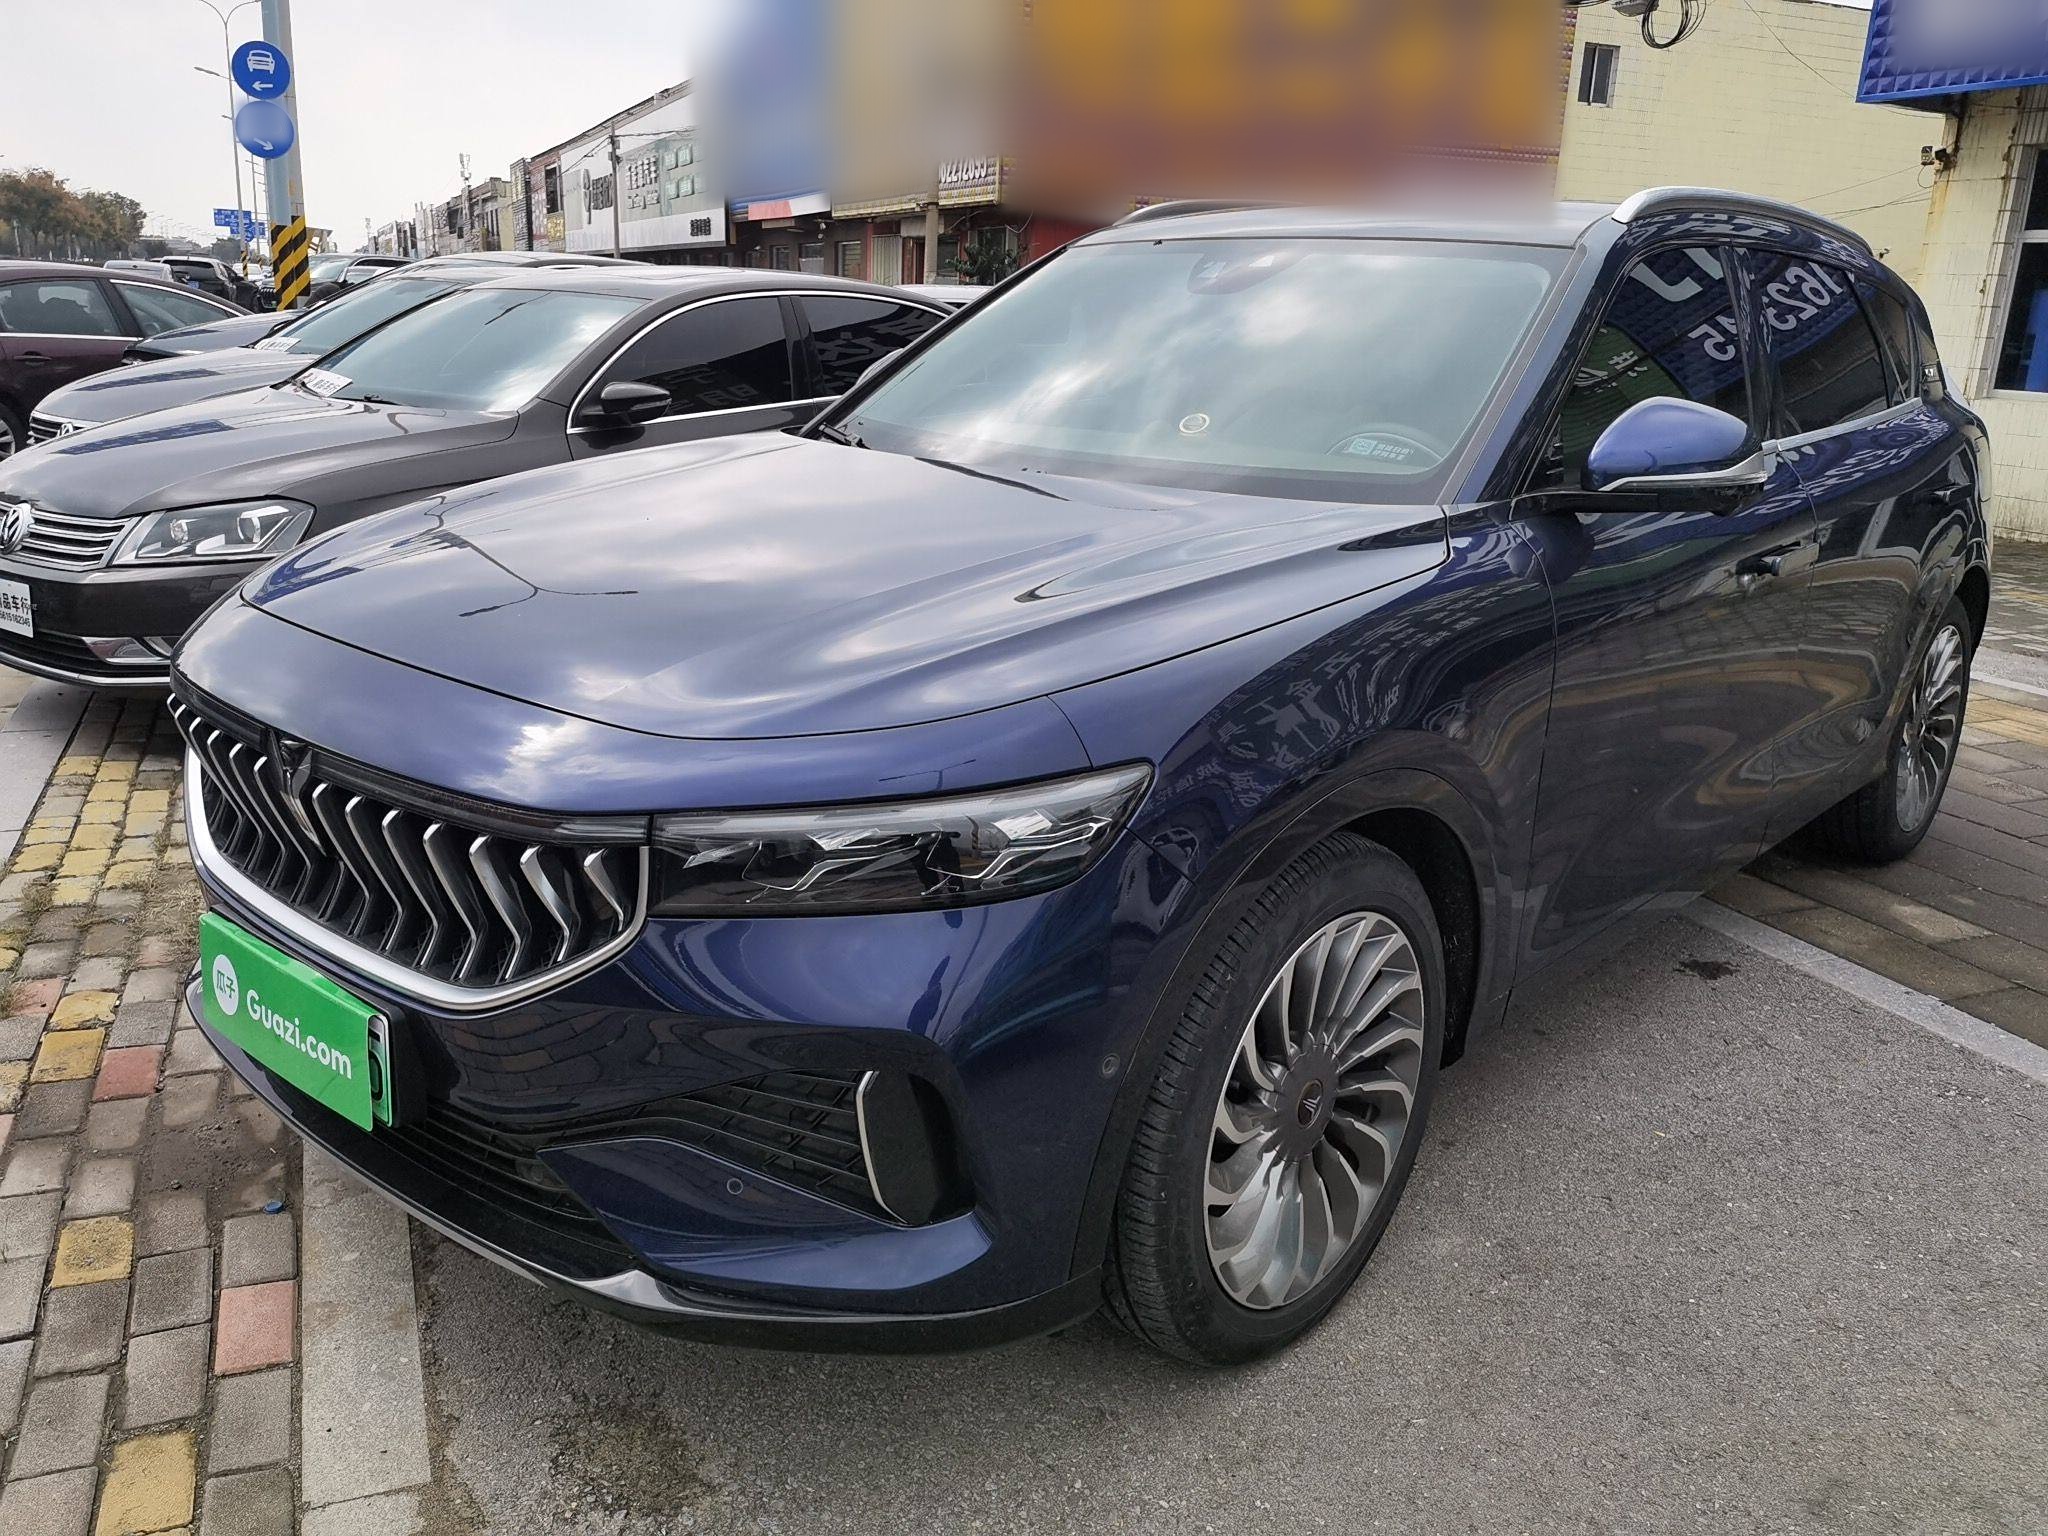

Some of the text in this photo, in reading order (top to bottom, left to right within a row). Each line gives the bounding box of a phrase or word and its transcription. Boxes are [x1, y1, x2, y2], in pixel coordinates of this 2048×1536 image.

[0, 592, 29, 615] 品车行
[216, 969, 236, 999] 瓜子
[246, 989, 353, 1079] Guazi.com
